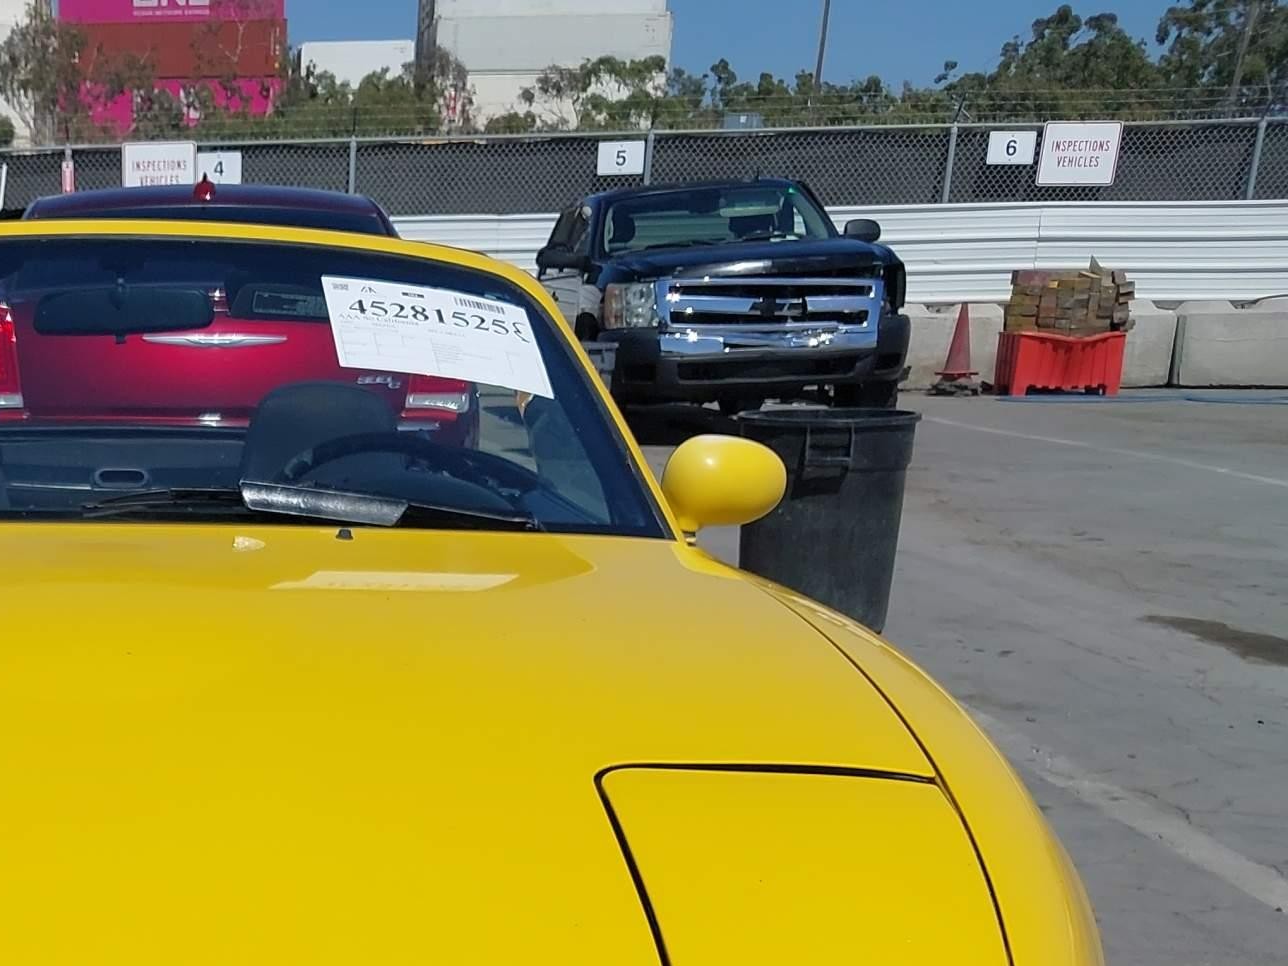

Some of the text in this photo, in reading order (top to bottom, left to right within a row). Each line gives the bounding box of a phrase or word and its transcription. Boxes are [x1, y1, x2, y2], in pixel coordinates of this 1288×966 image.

[1006, 139, 1017, 156] 6
[1052, 140, 1110, 152] INSPECTIONS
[616, 150, 626, 166] 5
[1057, 156, 1100, 168] VEHICLES
[132, 160, 187, 171] INSPECTIONS
[214, 161, 224, 176] 4
